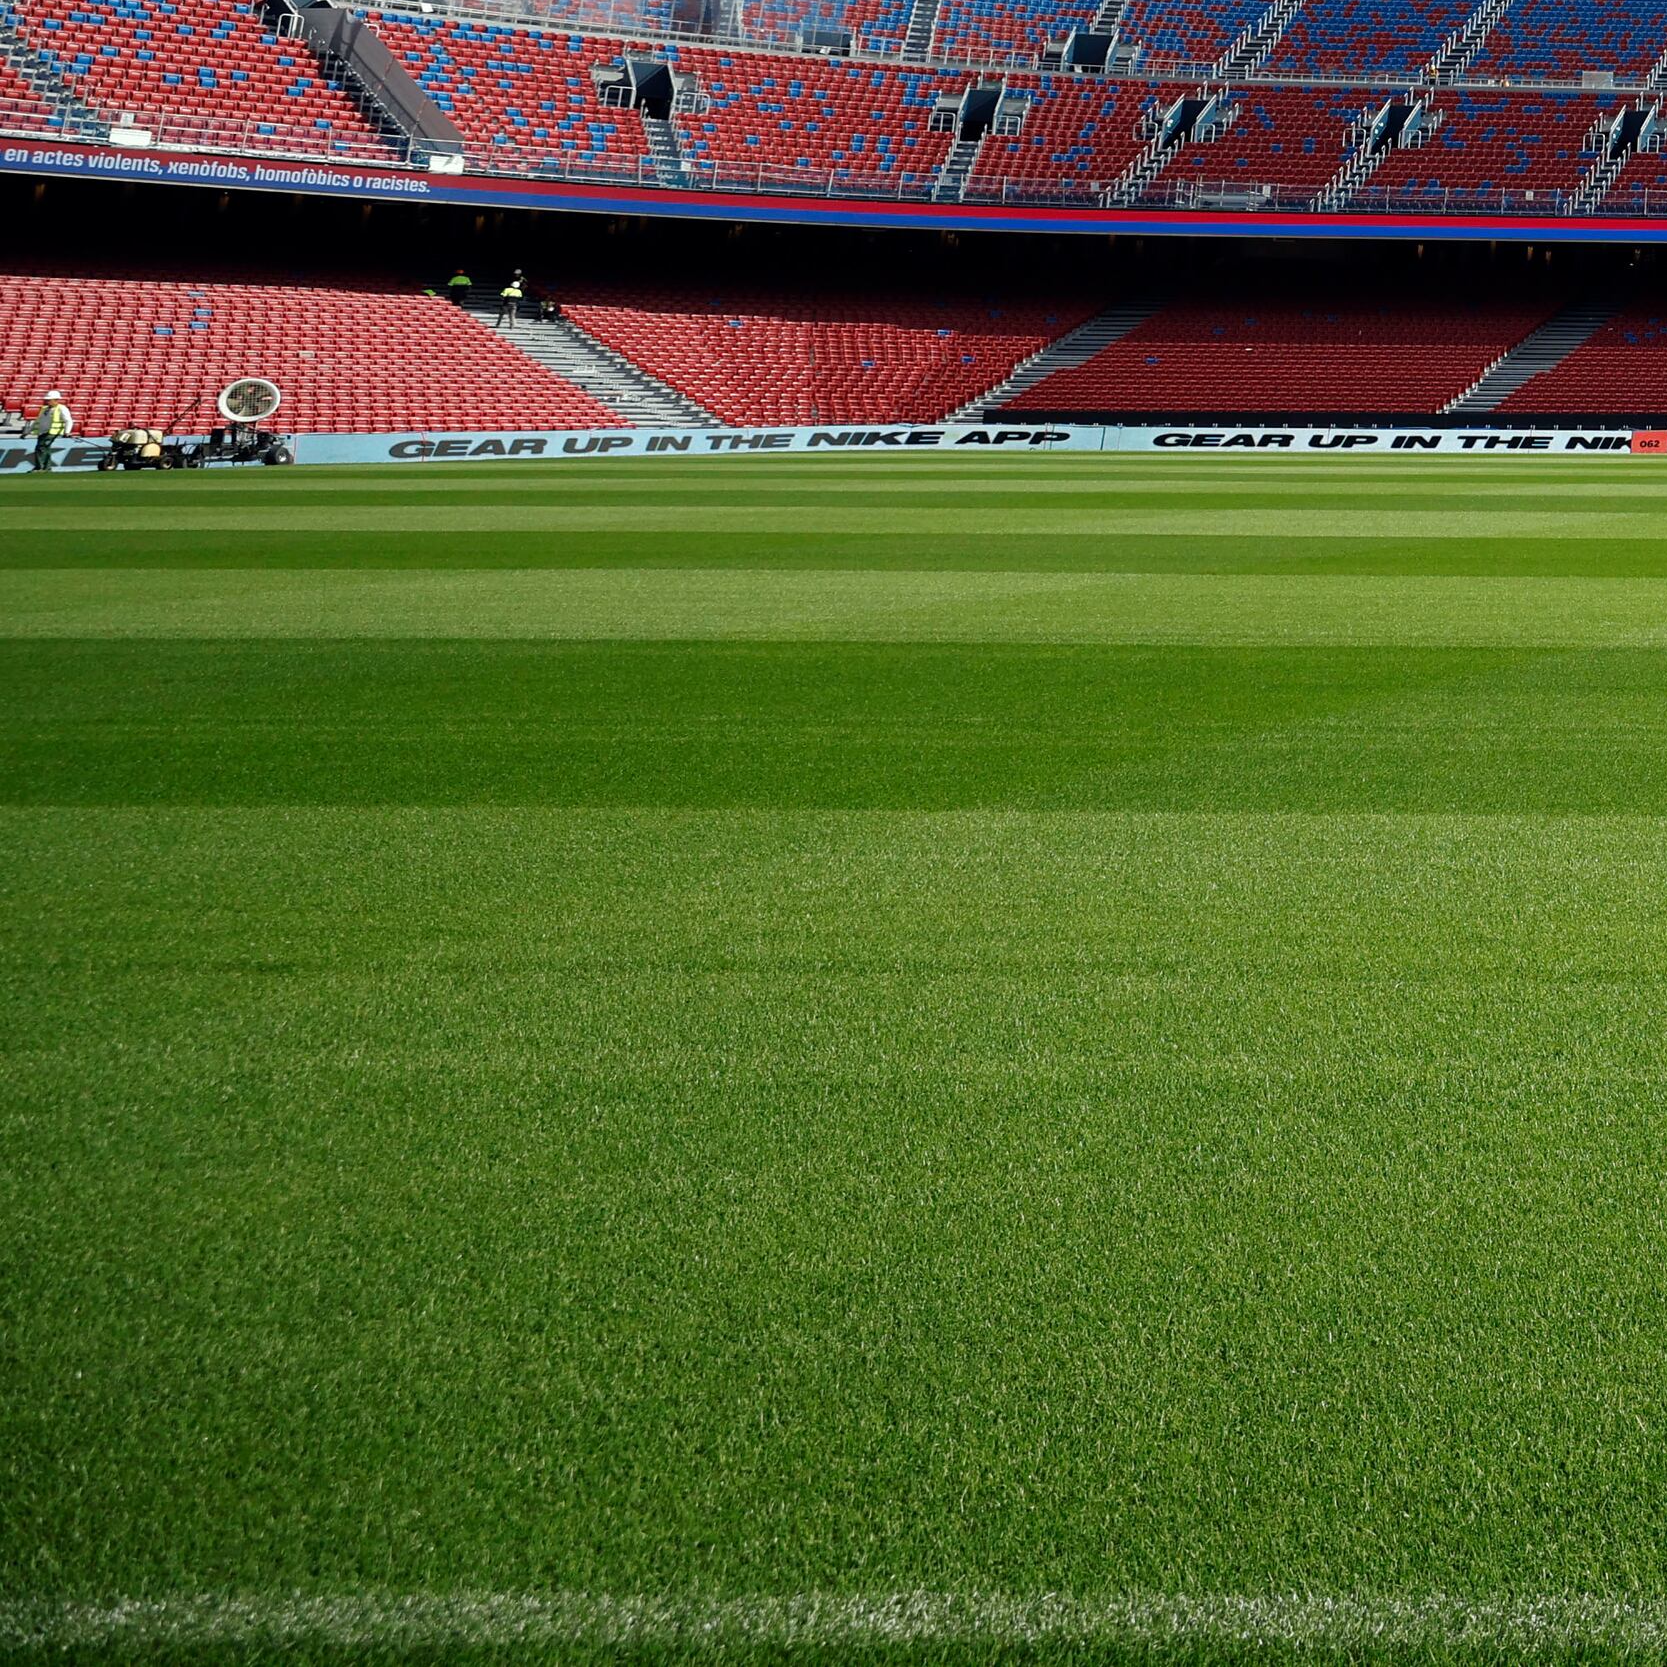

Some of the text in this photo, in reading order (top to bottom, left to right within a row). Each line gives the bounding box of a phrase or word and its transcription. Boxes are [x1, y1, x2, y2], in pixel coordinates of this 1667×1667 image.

[4, 149, 431, 193] en actes violents, xenòfobs, homofòbics o racistes.
[388, 430, 1071, 459] GEAR UP IN THE NIKE APP
[1153, 433, 1295, 449] GEAR
[1308, 434, 1379, 449] UP
[1390, 435, 1442, 449] IN
[1457, 435, 1554, 450] THE
[1639, 440, 1660, 449] 062
